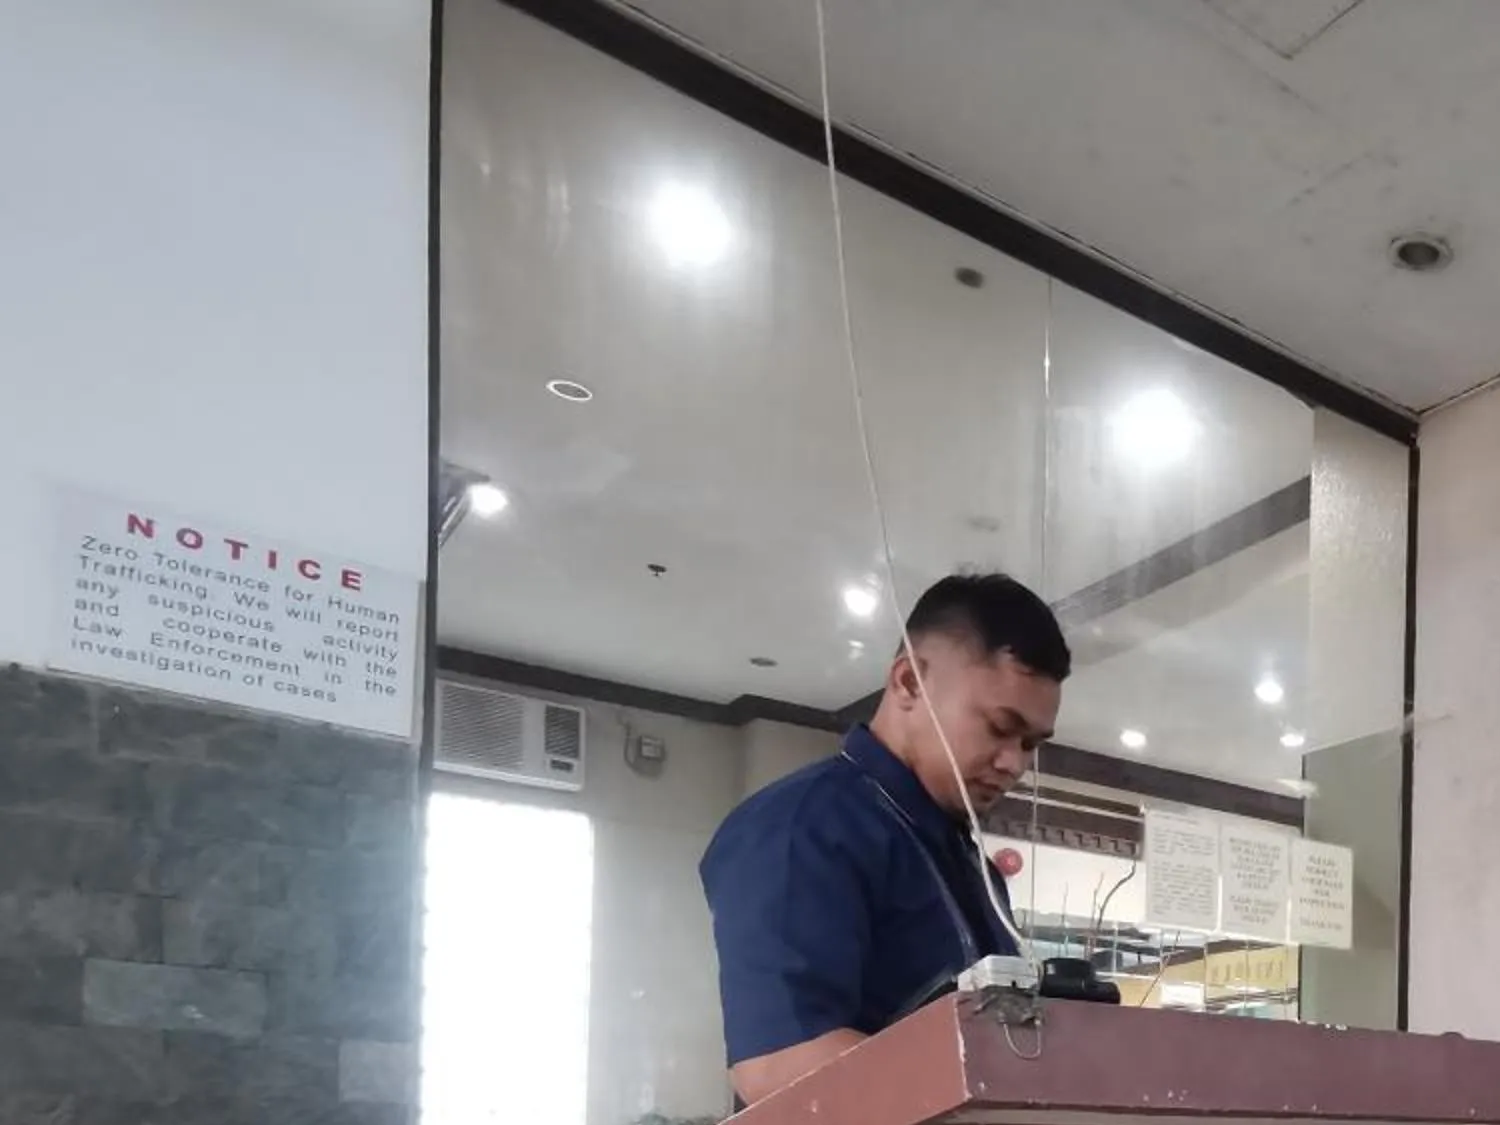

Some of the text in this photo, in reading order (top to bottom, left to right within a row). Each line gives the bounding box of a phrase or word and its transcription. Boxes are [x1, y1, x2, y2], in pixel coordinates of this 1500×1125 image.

[81, 535, 400, 624] Zero Tolerance for Human
[127, 513, 362, 591] NOTICE
[73, 615, 397, 697] Law Enforcement in the
[74, 598, 397, 678] and cooperate with the
[76, 578, 398, 662] any suspicious activity
[233, 590, 270, 611] We
[285, 606, 321, 624] will
[337, 618, 399, 642] report
[72, 637, 337, 703] investigation of cases
